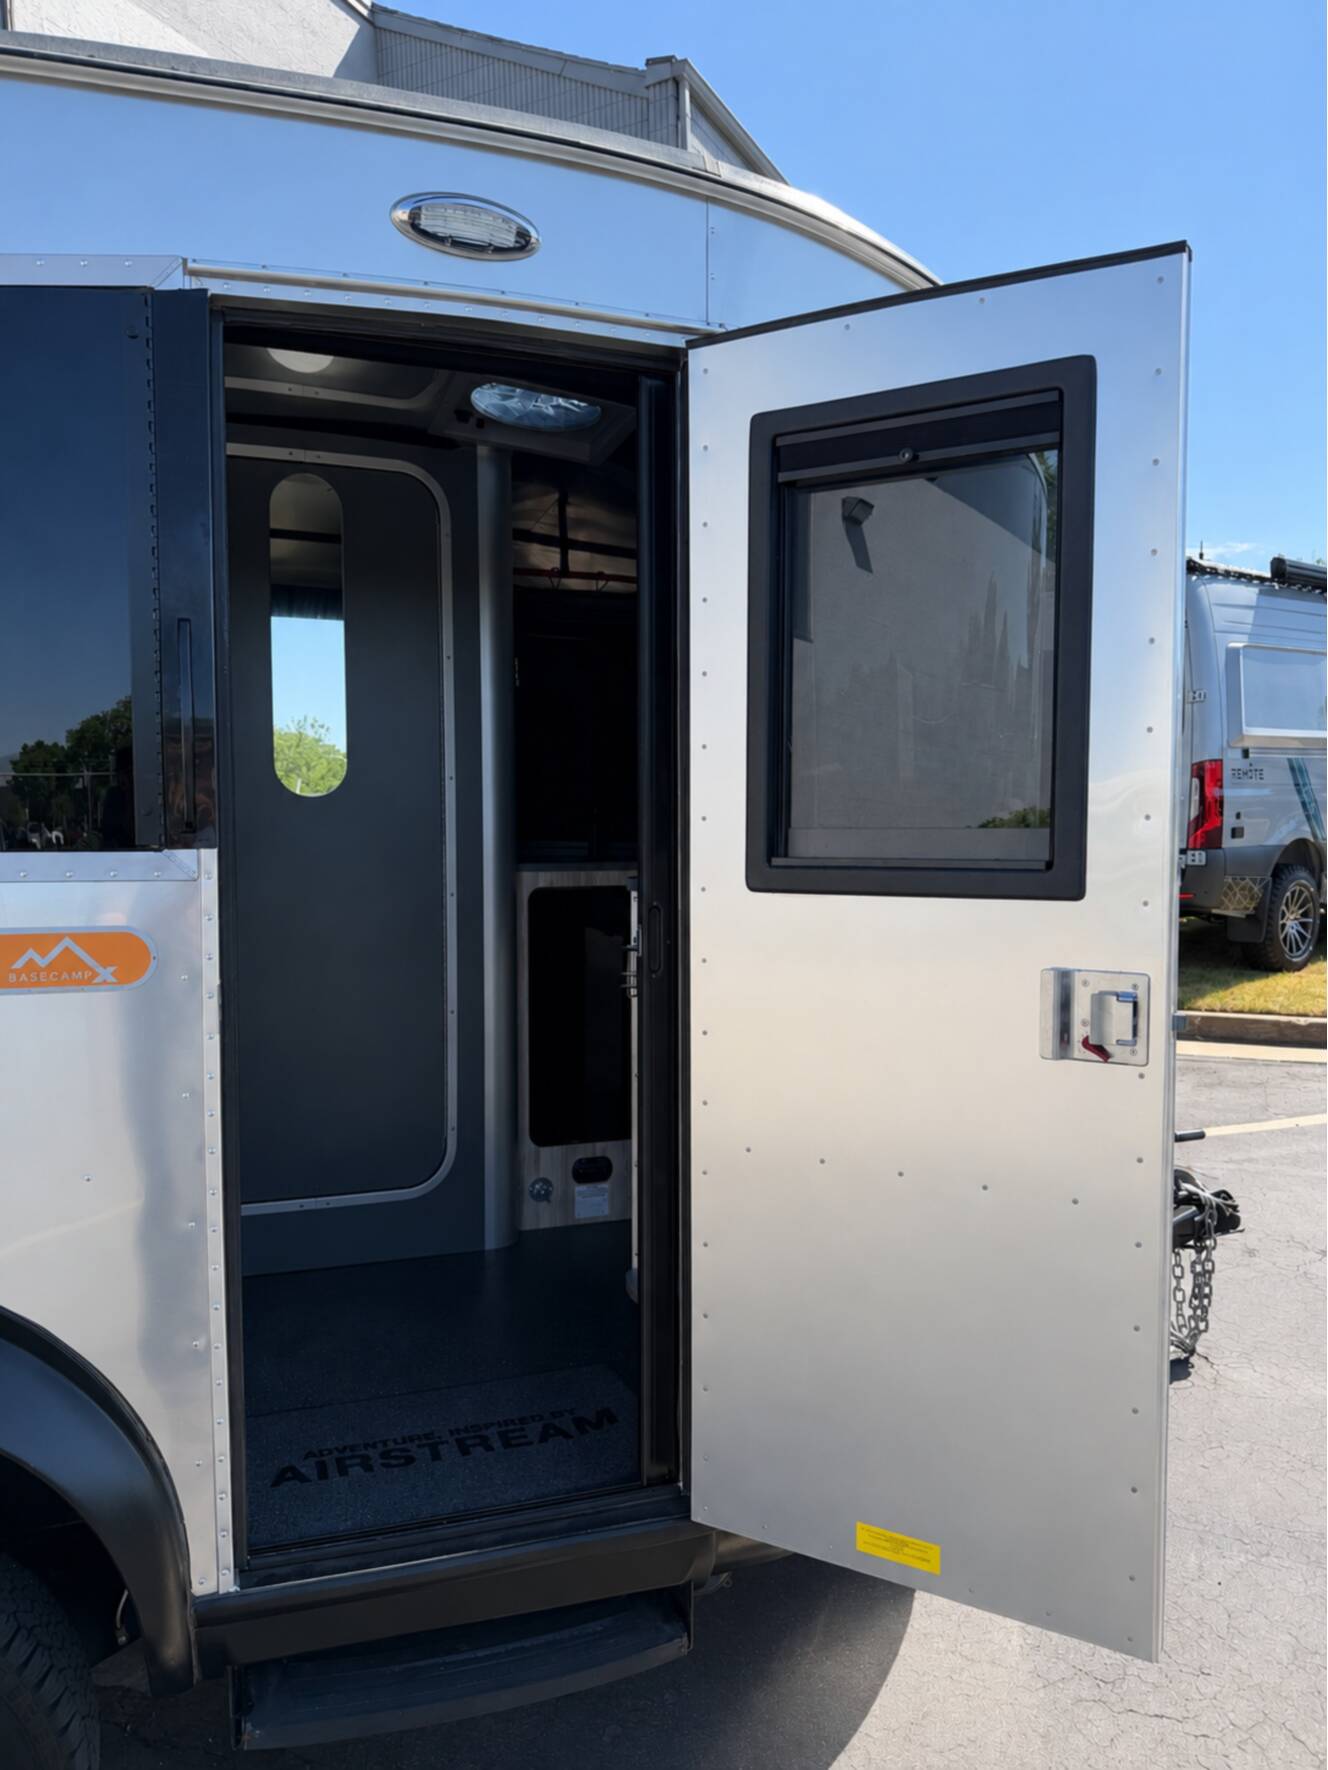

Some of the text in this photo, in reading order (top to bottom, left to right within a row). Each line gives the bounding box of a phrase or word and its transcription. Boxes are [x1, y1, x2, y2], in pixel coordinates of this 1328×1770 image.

[1232, 768, 1264, 781] REMOTE
[8, 971, 92, 983] BASECAMP
[449, 1414, 544, 1437] INSPIRED
[270, 1407, 619, 1488] AIRSTREAM
